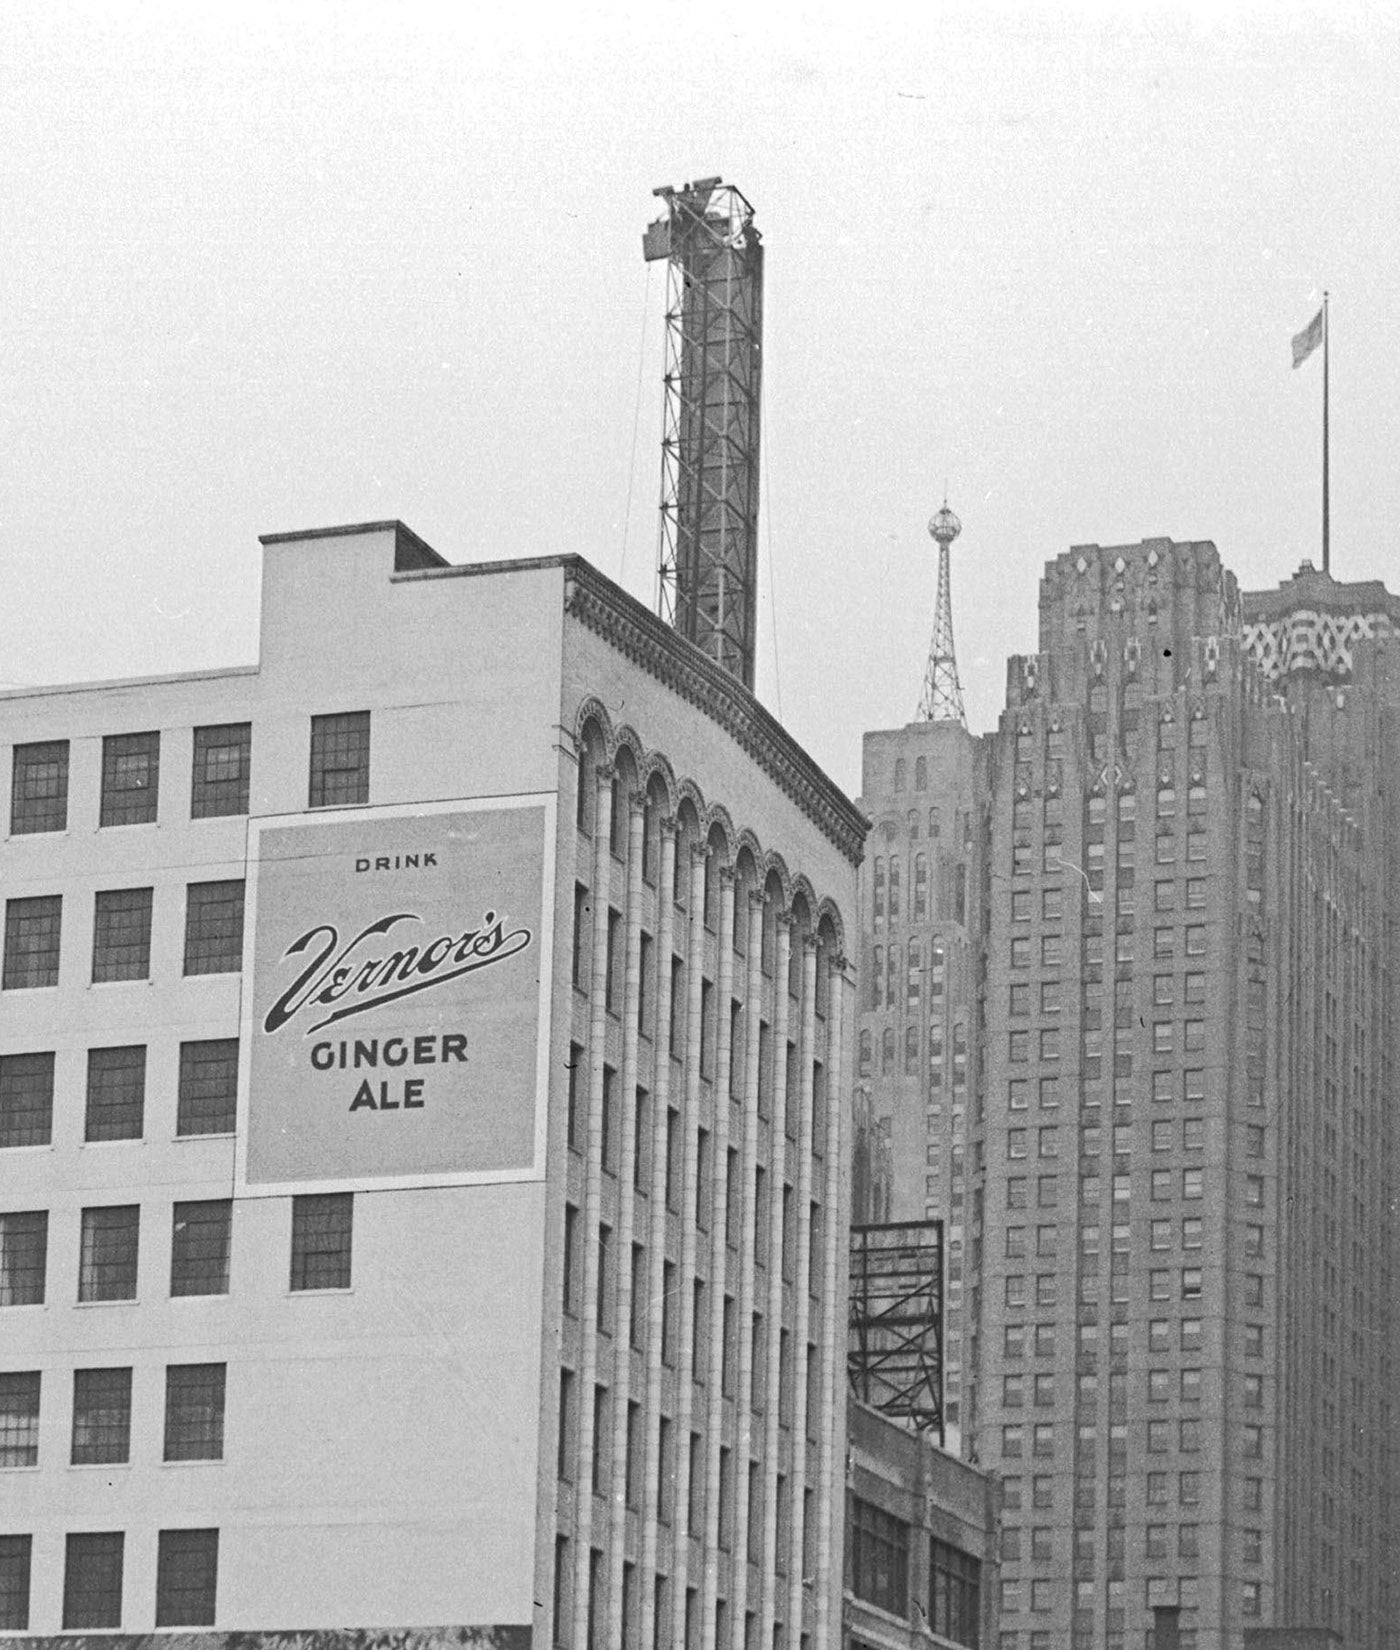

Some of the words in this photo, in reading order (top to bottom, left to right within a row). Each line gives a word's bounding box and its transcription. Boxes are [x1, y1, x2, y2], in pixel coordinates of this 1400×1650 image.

[355, 853, 438, 873] DRINK
[263, 911, 532, 1035] Vernor's
[311, 1034, 469, 1071] GINGER
[348, 1078, 426, 1112] ALE
